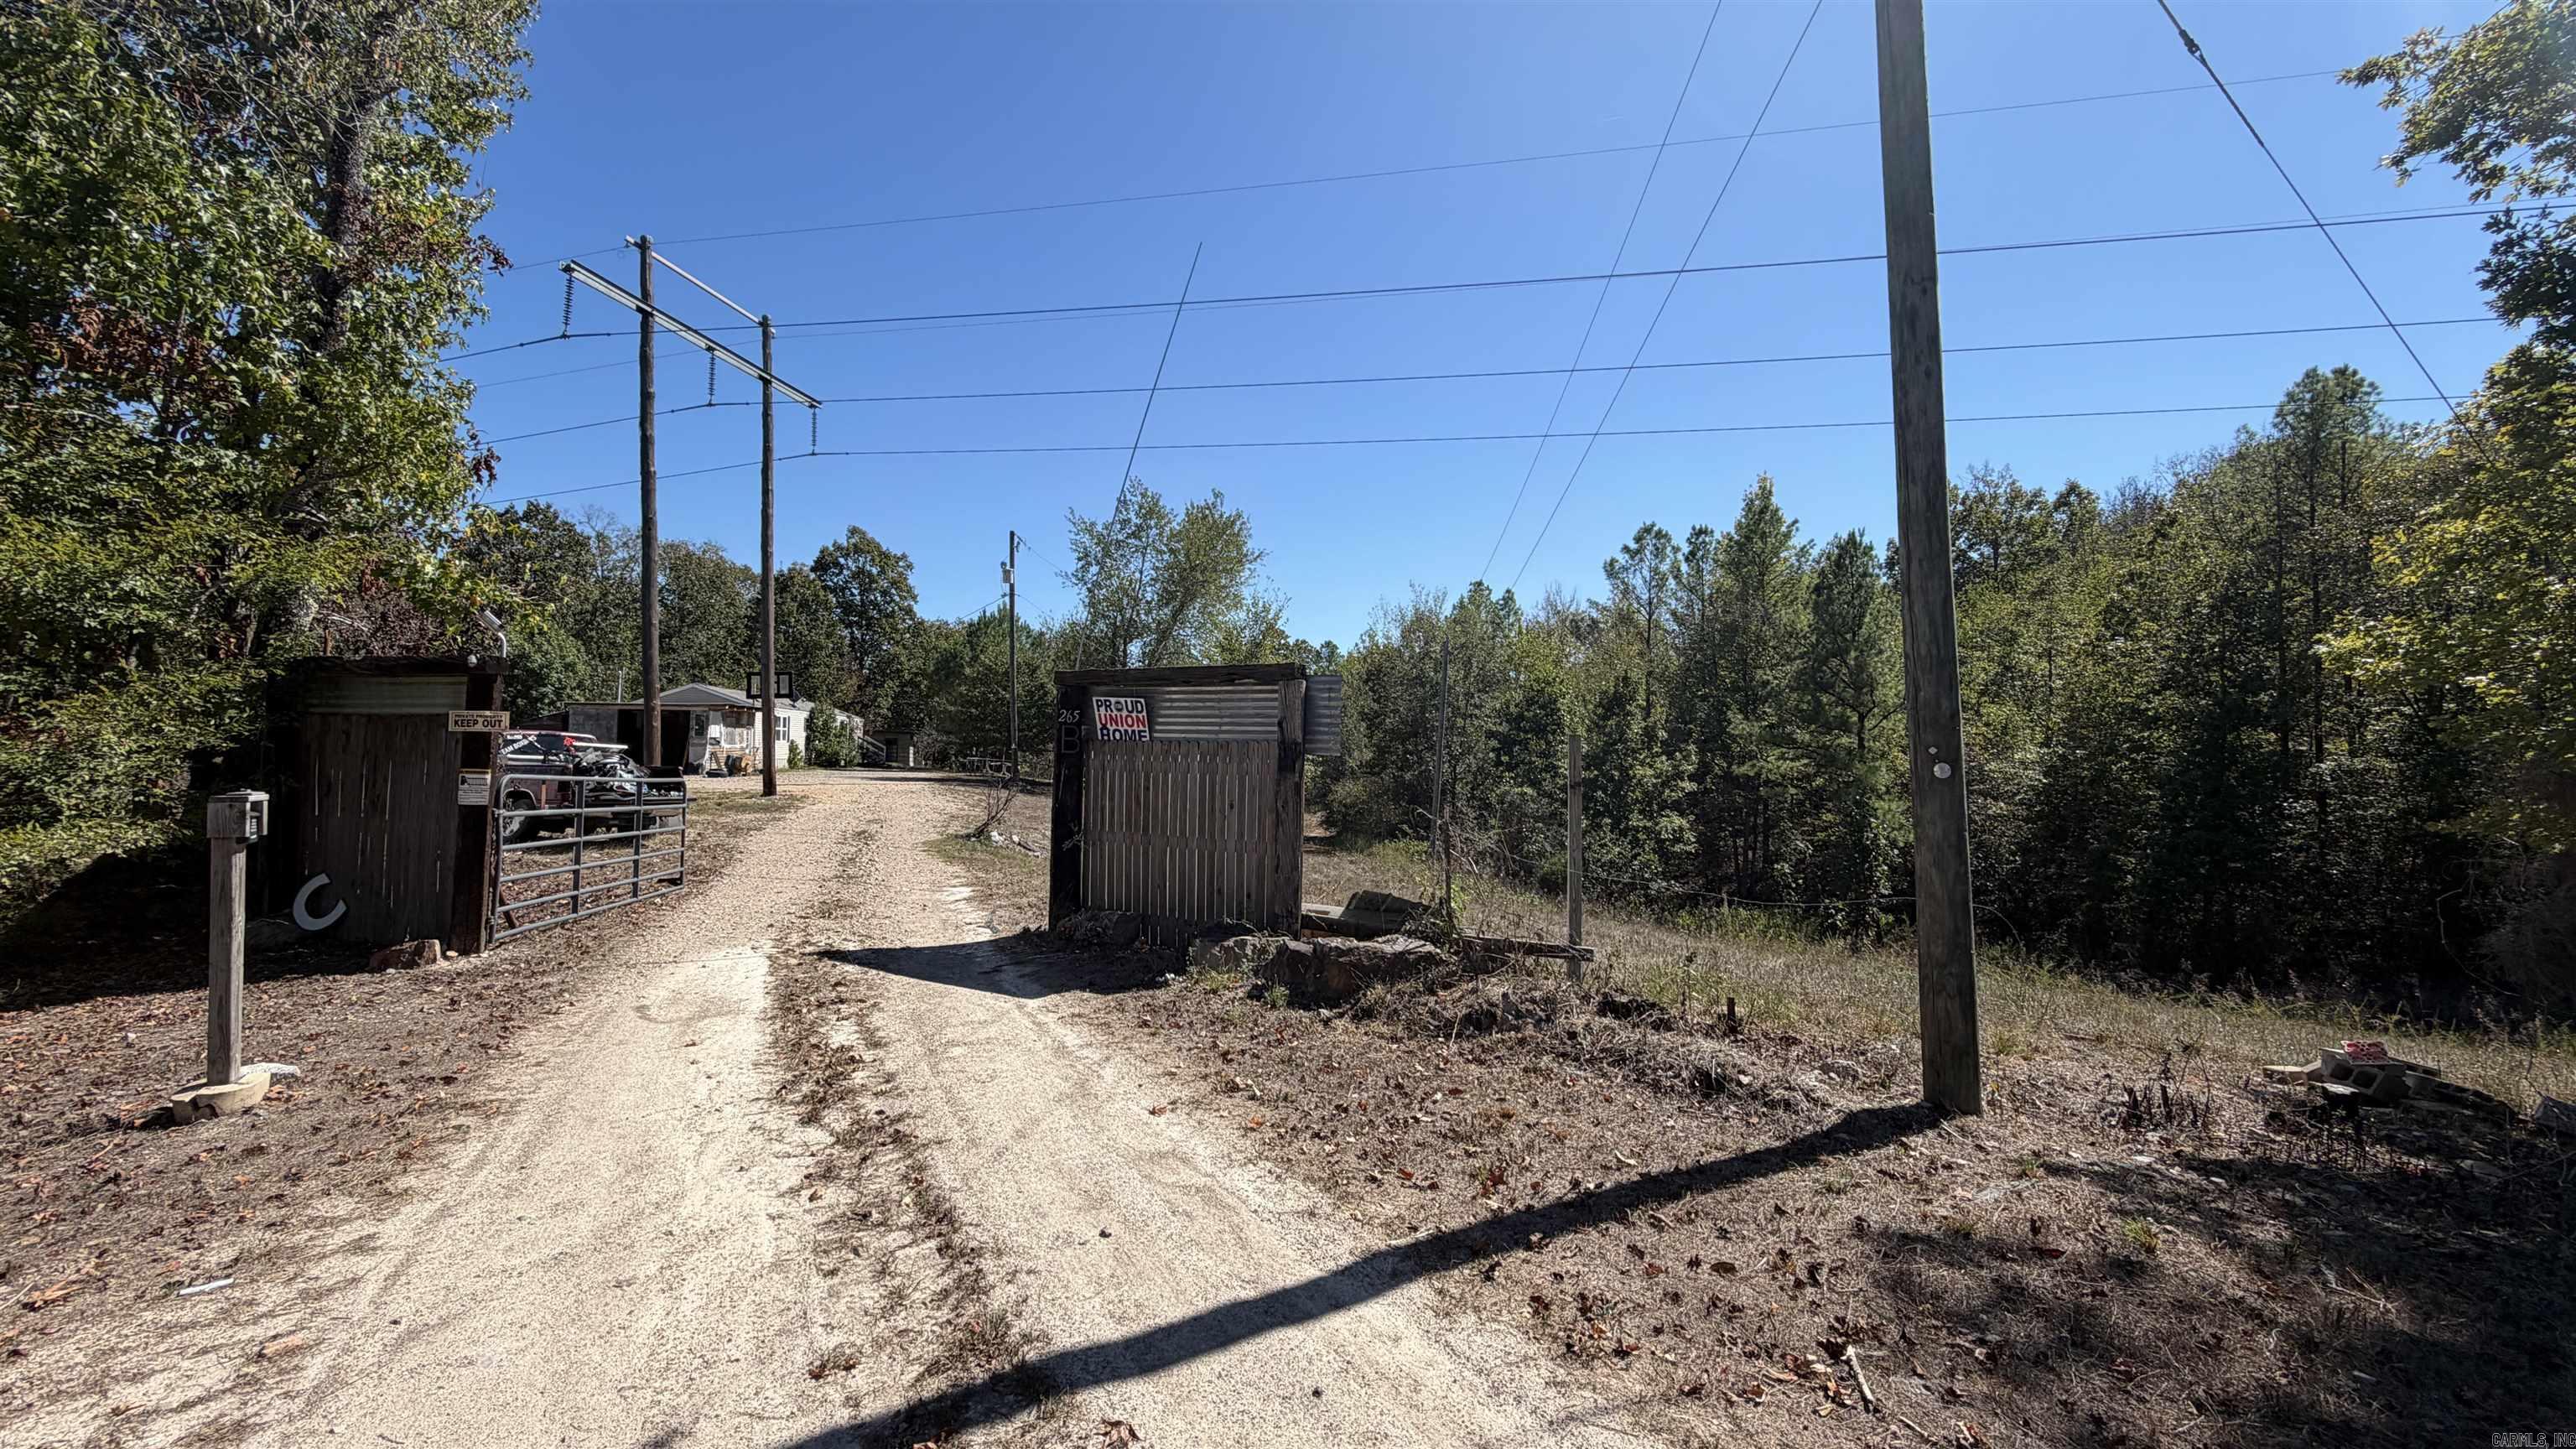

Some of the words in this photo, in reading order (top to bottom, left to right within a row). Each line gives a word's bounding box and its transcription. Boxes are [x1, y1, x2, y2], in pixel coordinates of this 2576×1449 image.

[1096, 699, 1144, 714] PROUD
[454, 719, 479, 728] KEEP
[482, 719, 503, 728] OUT
[1058, 709, 1081, 723] 265
[1098, 713, 1146, 729] UNION
[1100, 727, 1148, 742] HOME
